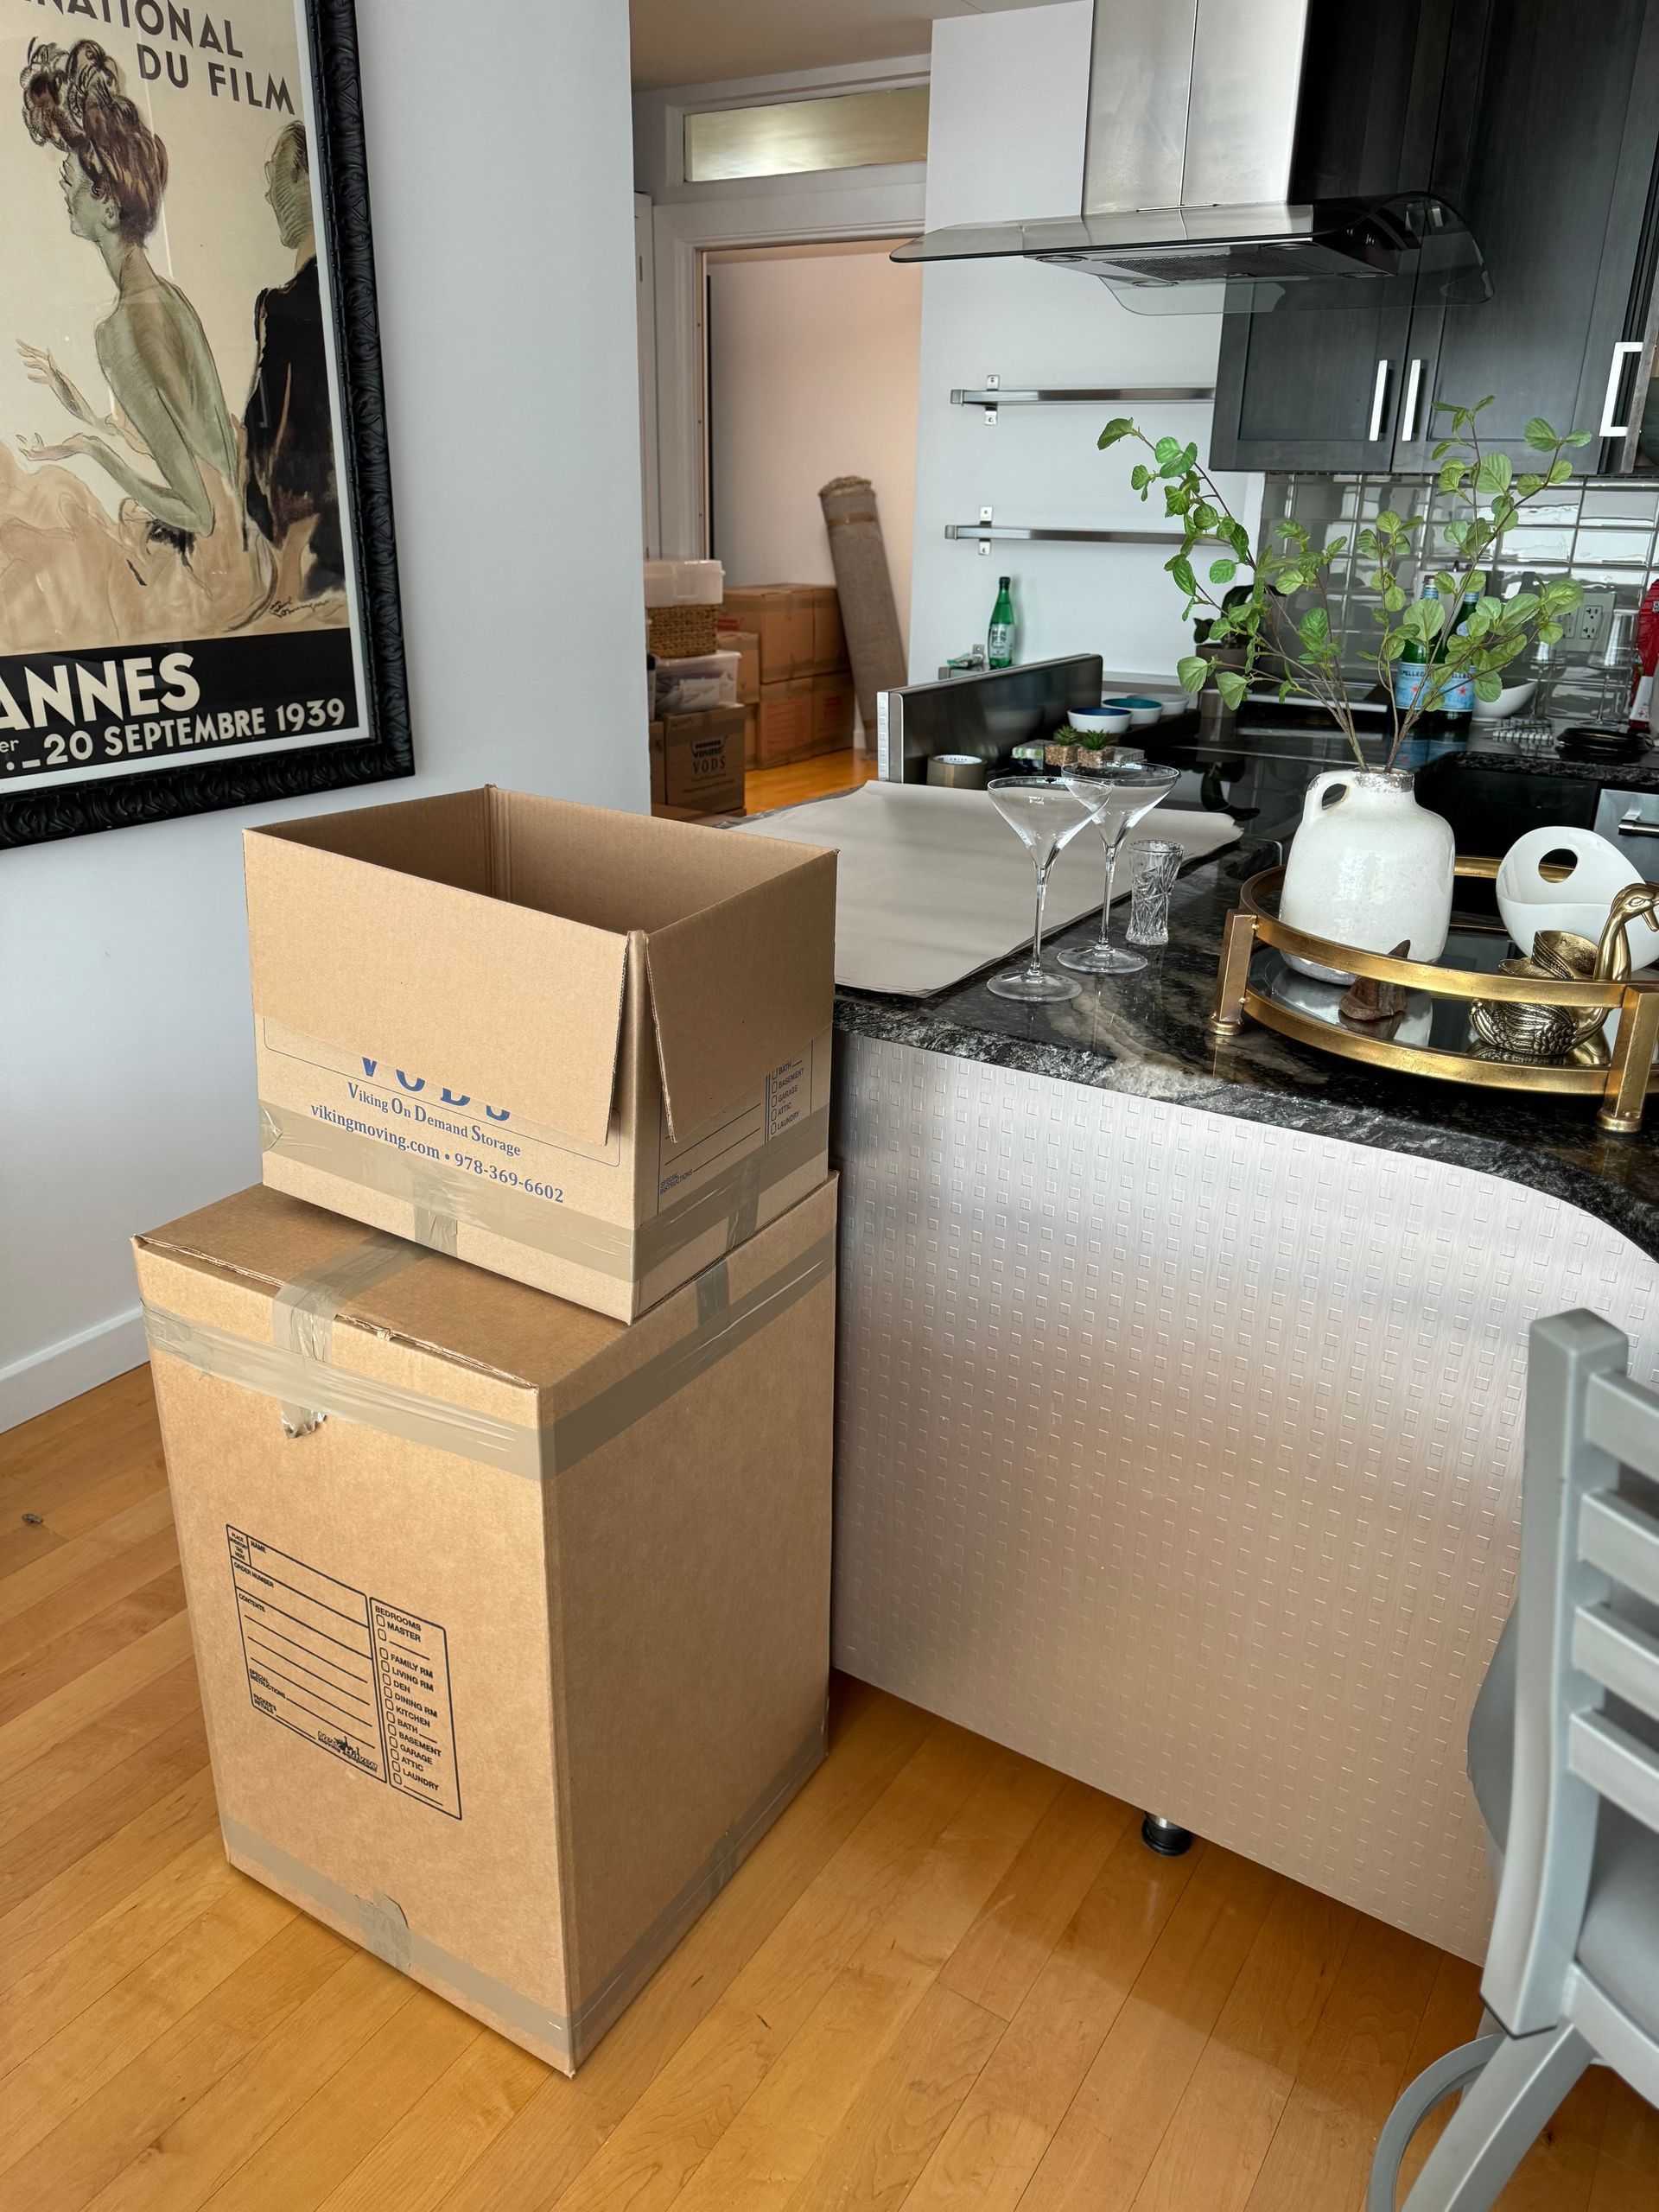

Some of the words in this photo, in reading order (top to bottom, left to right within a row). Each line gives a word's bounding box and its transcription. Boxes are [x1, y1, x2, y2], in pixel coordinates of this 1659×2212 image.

[137, 43, 189, 88] DU
[207, 61, 296, 115] FILM
[105, 707, 266, 756] SEPTEMBRE
[275, 697, 346, 733] 1939
[693, 755, 726, 774] VODS
[779, 1060, 792, 1075] BATH
[779, 1067, 804, 1089] BASEMENT
[778, 1084, 798, 1103] GARAGE
[347, 1081, 389, 1114] Viking
[391, 1097, 411, 1119] On
[414, 1104, 468, 1139] Demand
[471, 1125, 521, 1157] Storage
[777, 1109, 800, 1130] LAUNDRY
[778, 1102, 791, 1116] ATTIC
[310, 1104, 440, 1160] vikingmoving.com
[454, 1153, 564, 1204] 978-369-6602
[375, 1605, 422, 1631] BEDROOMS
[387, 1621, 421, 1643] MASTER
[391, 1653, 418, 1671] FAMILY
[420, 1667, 434, 1679] RM
[392, 1667, 419, 1685] LIVING
[420, 1680, 434, 1692] RM
[393, 1680, 410, 1694] DEN
[394, 1693, 423, 1711] DINING
[423, 1706, 438, 1719] RM
[396, 1706, 430, 1728] KITCHEN
[397, 1719, 418, 1734] BATH
[398, 1731, 442, 1758] BASEMENT
[400, 1745, 433, 1765] GARAGE
[401, 1757, 424, 1771] ATTIC
[403, 1768, 439, 1791] LAUNDRY
